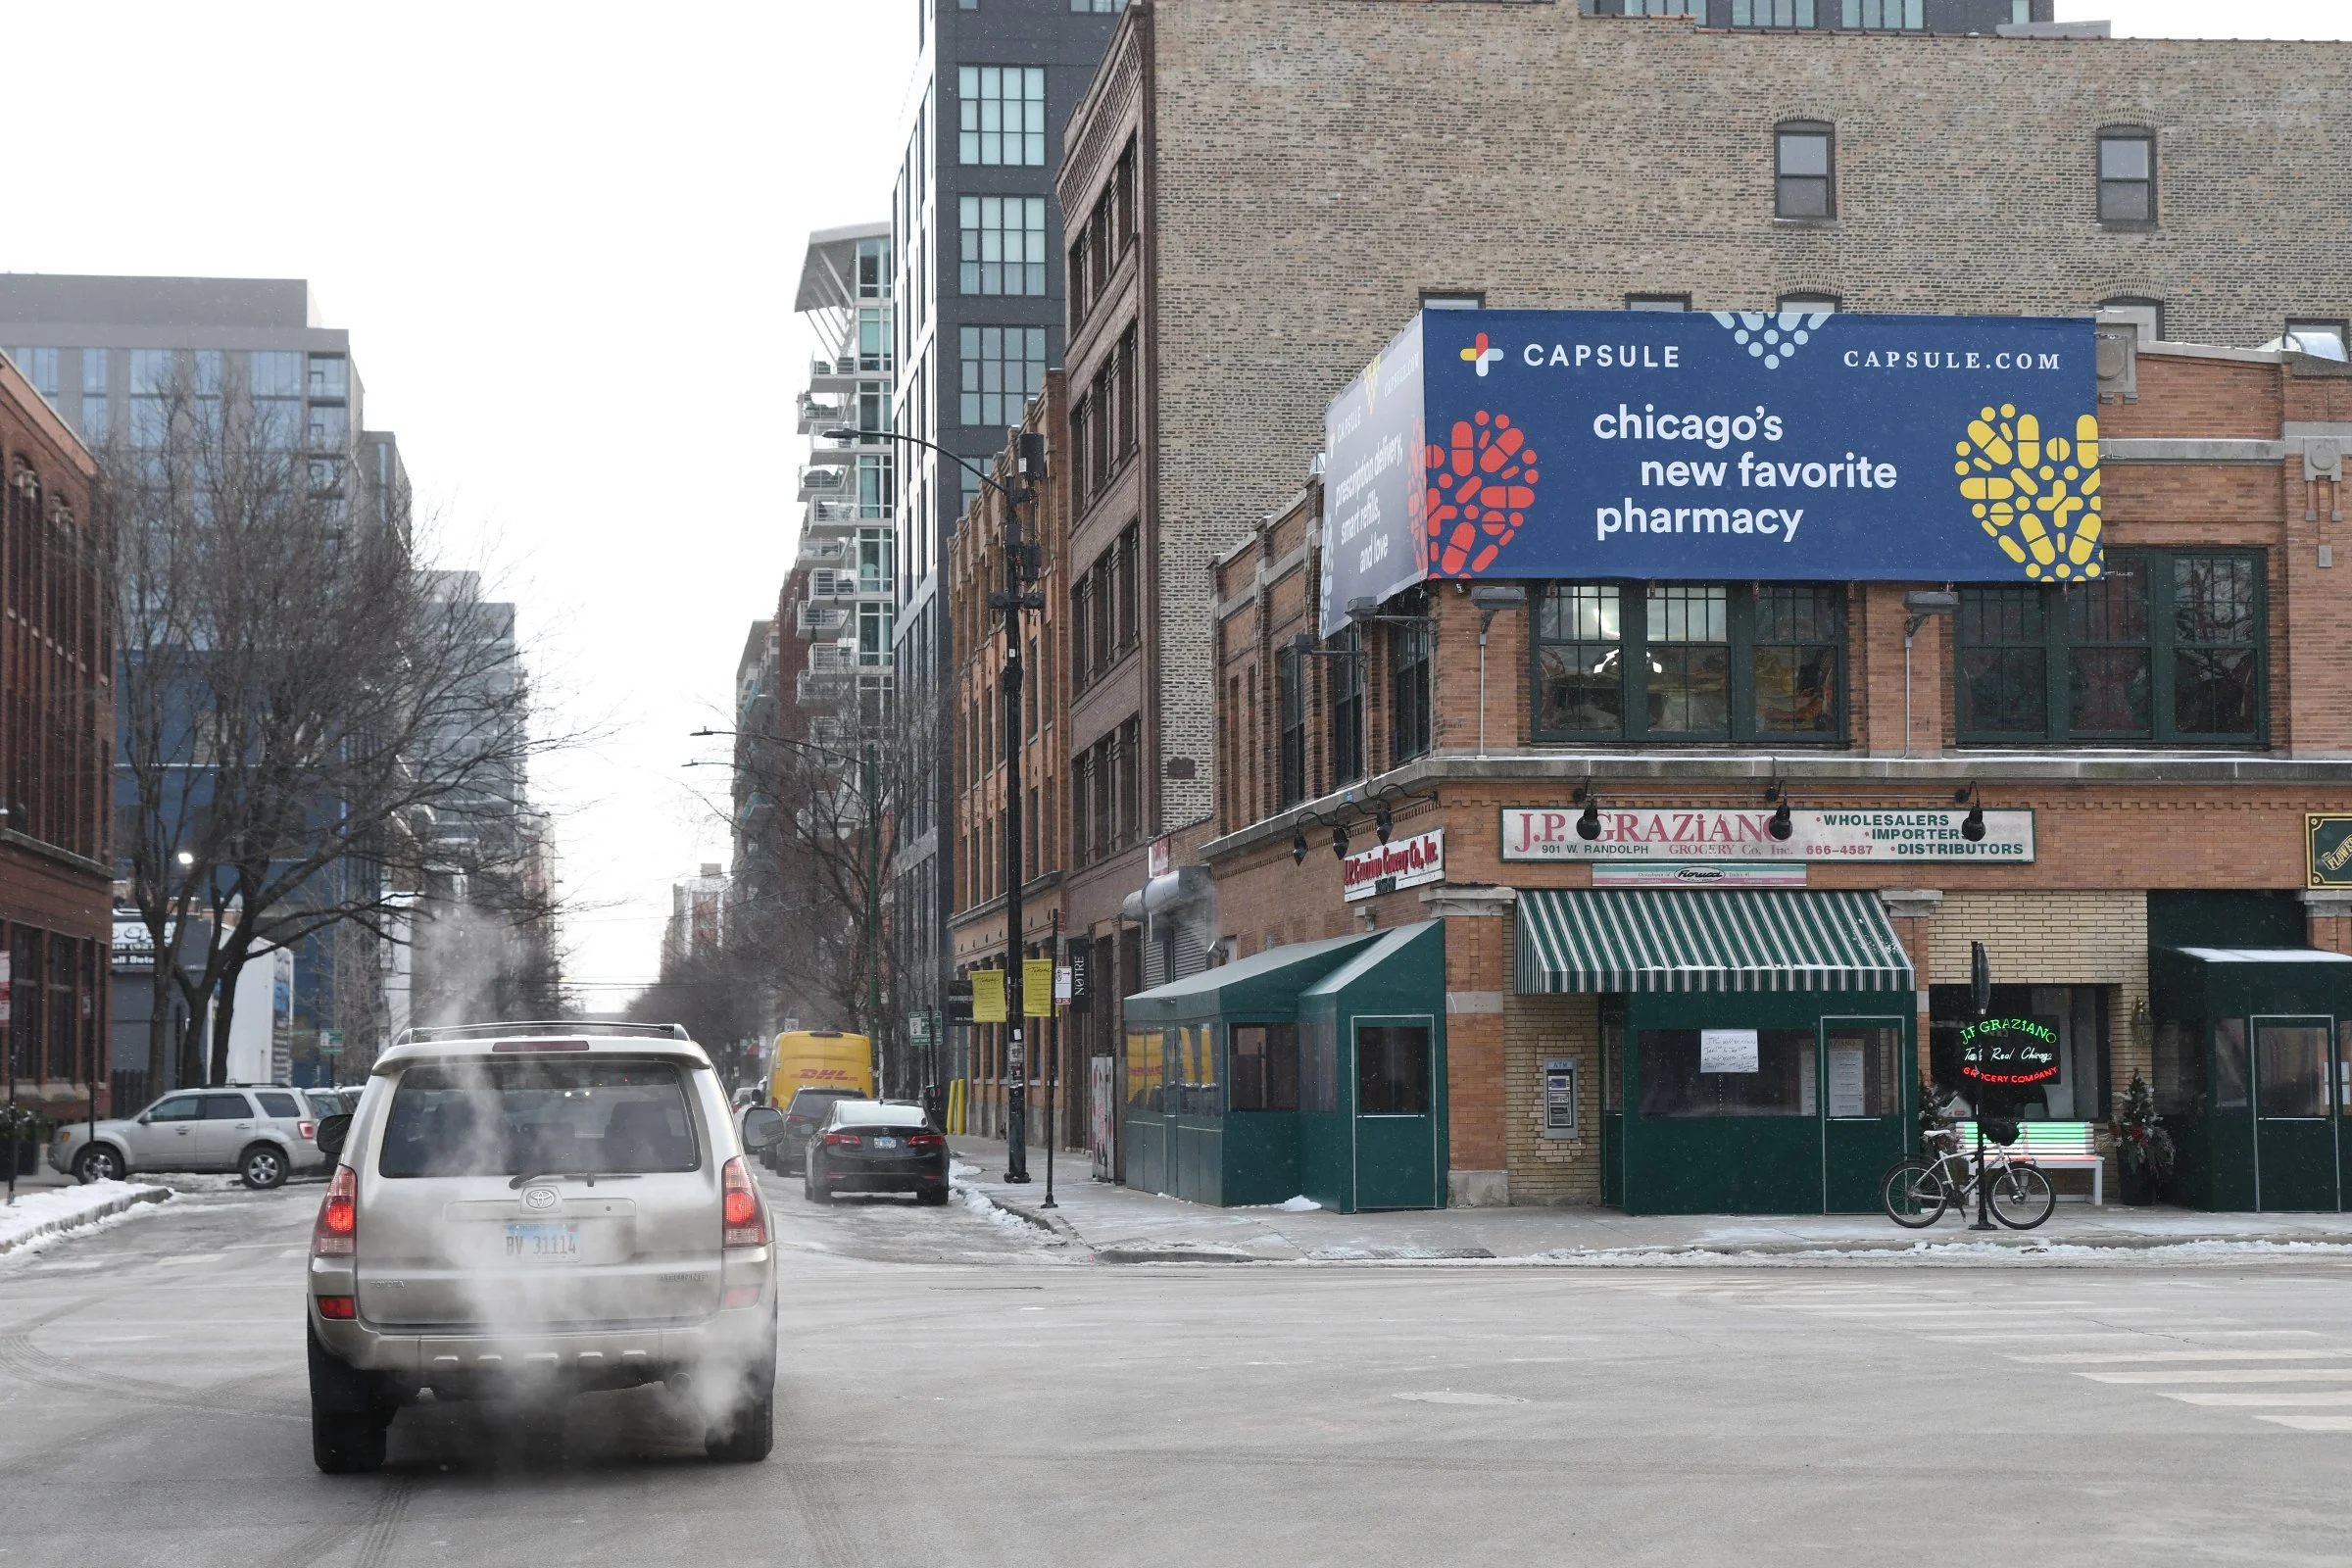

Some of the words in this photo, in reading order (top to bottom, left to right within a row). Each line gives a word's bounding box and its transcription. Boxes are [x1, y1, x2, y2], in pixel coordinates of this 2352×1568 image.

[1523, 343, 1680, 368] CAPSULE
[1843, 350, 2060, 370] CAPSULE.COM
[1337, 406, 1361, 444] CAPSULE
[1592, 403, 1784, 450] chicago's
[1336, 456, 1374, 514] prescription
[1374, 433, 1402, 474] delivery,
[1641, 460, 1728, 487] new
[1738, 451, 1897, 488] favorite
[1341, 508, 1360, 545] smart
[1360, 491, 1381, 525] refills,
[1596, 497, 1804, 542] pharmacy
[1359, 539, 1373, 574] and
[1373, 532, 1388, 564] love
[1514, 812, 1566, 853] J.P.
[1824, 814, 1949, 826] WHOLESALERS
[1542, 845, 1561, 854] 901
[1567, 845, 1579, 854] W.
[1584, 845, 1648, 854] RANDOLPH
[1668, 844, 1735, 855] GROCERY
[1771, 845, 1793, 856] Inc.
[1806, 845, 1874, 856] 666-4587
[1897, 843, 2024, 855] DISTRIBUTORS
[2328, 837, 2352, 868] FLOWE
[1990, 1046, 2015, 1062] Real
[2021, 1046, 2053, 1063] Chicago
[799, 1068, 849, 1081] DHL
[1963, 1066, 2009, 1083] GRCERY
[2011, 1066, 2058, 1083] COMPANY
